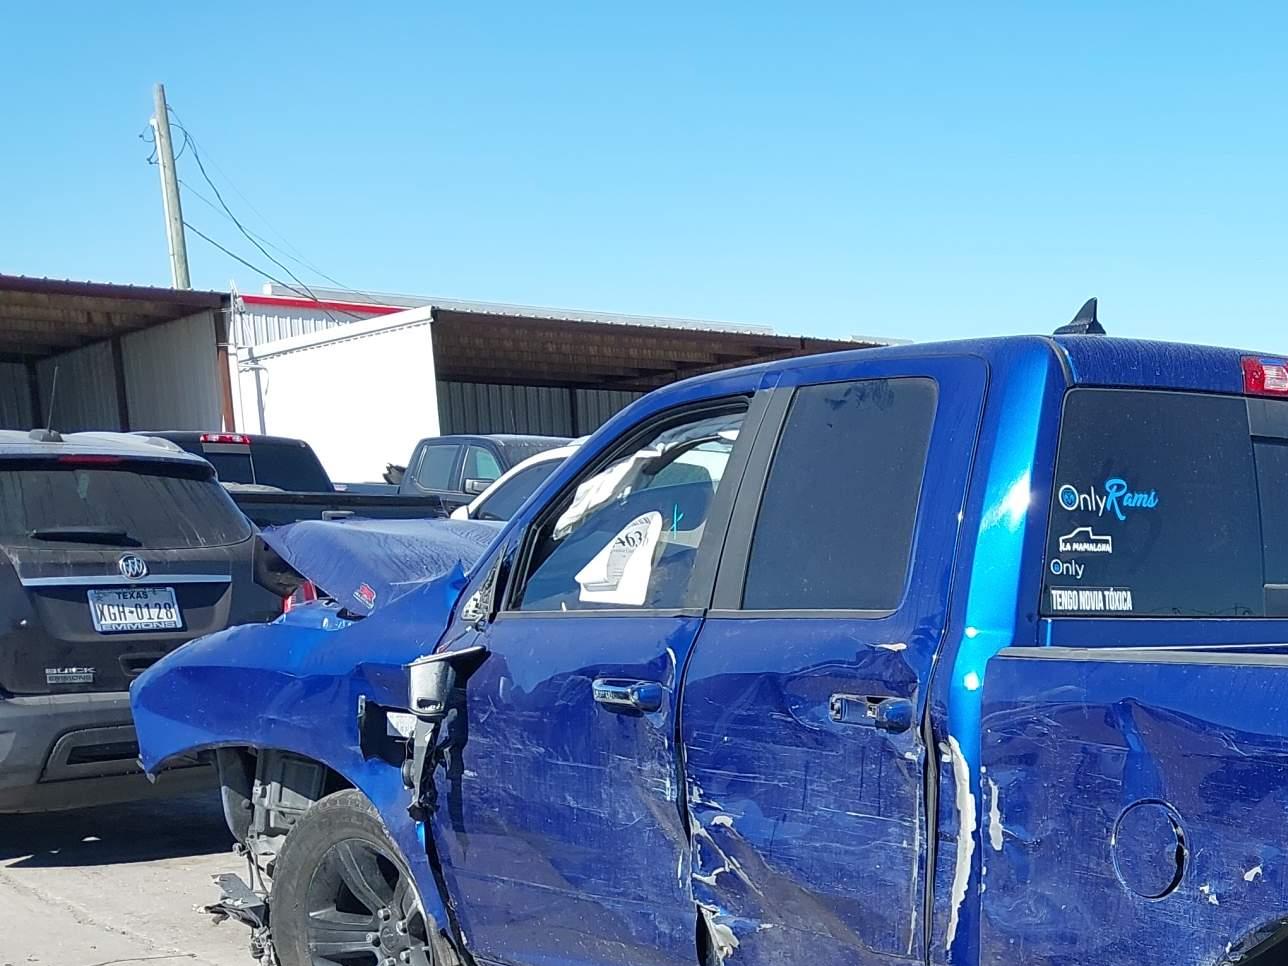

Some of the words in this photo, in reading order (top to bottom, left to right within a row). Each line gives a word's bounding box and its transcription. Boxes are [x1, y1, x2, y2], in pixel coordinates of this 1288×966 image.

[1051, 559, 1084, 578] Only
[115, 590, 149, 600] TEXAS
[1051, 590, 1079, 611] TENGO
[1079, 590, 1104, 611] NOVIA
[1104, 587, 1132, 611] TÓXICA
